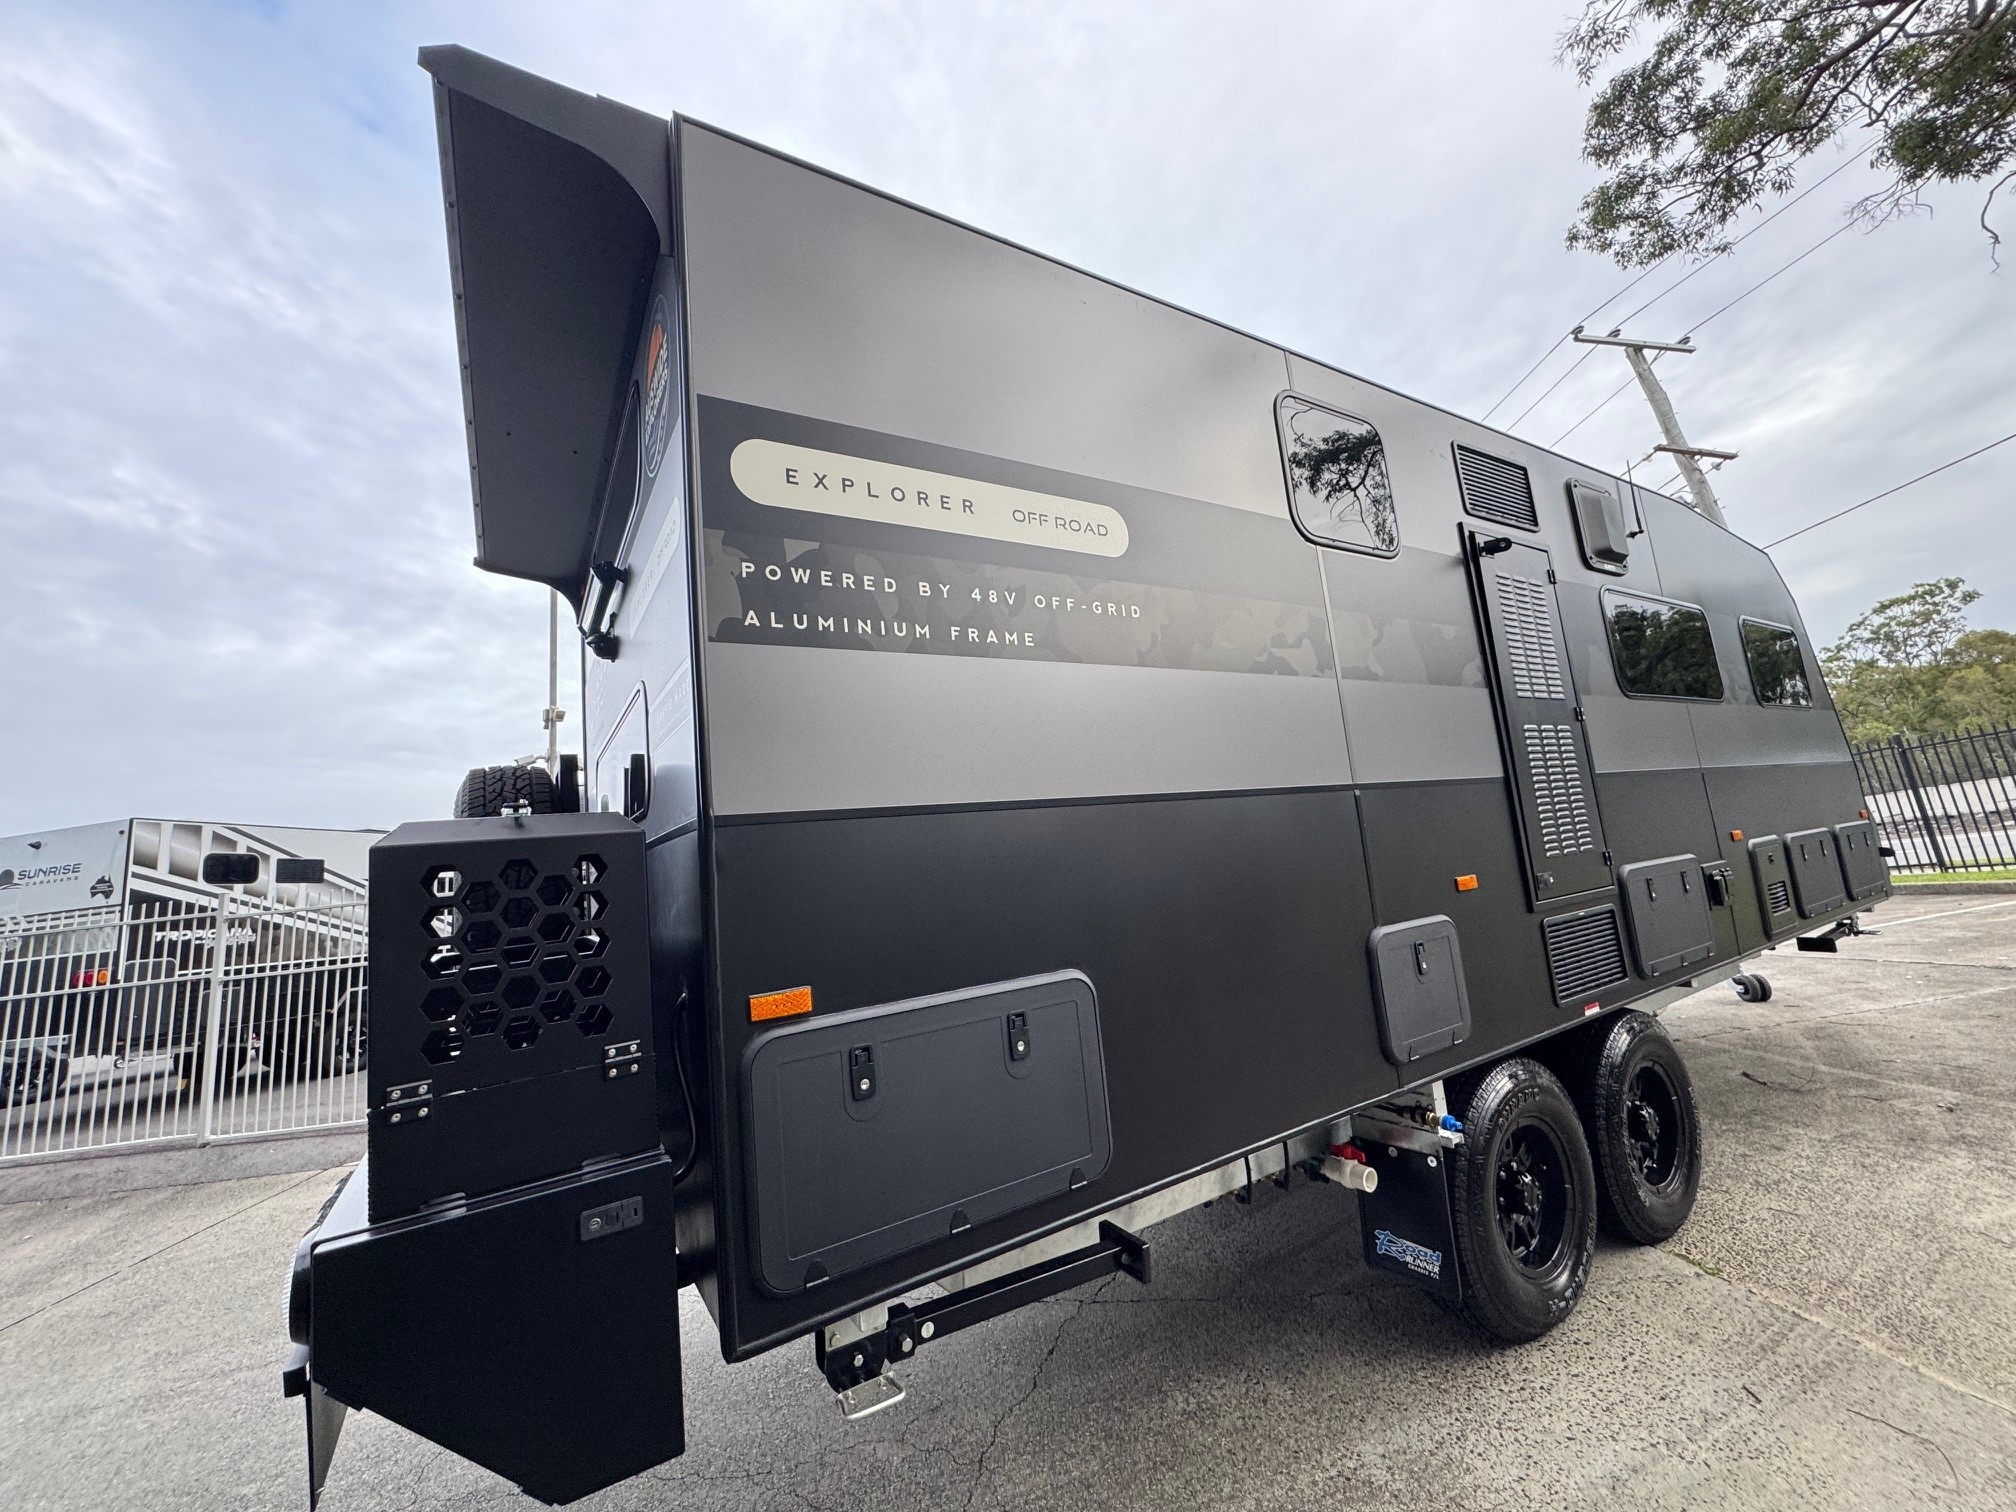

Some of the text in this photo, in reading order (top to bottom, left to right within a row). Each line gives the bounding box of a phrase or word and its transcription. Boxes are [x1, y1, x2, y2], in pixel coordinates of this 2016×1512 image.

[784, 467, 1109, 537] EXPLORER OFF ROAD
[741, 561, 1140, 618] POWERED BY 48V OFF-GRID
[744, 609, 1035, 646] ALUMINIUM FRAME
[17, 862, 82, 881] SUNRISE
[25, 875, 79, 887] CARAVANS
[1405, 1254, 1440, 1275] RUNNER
